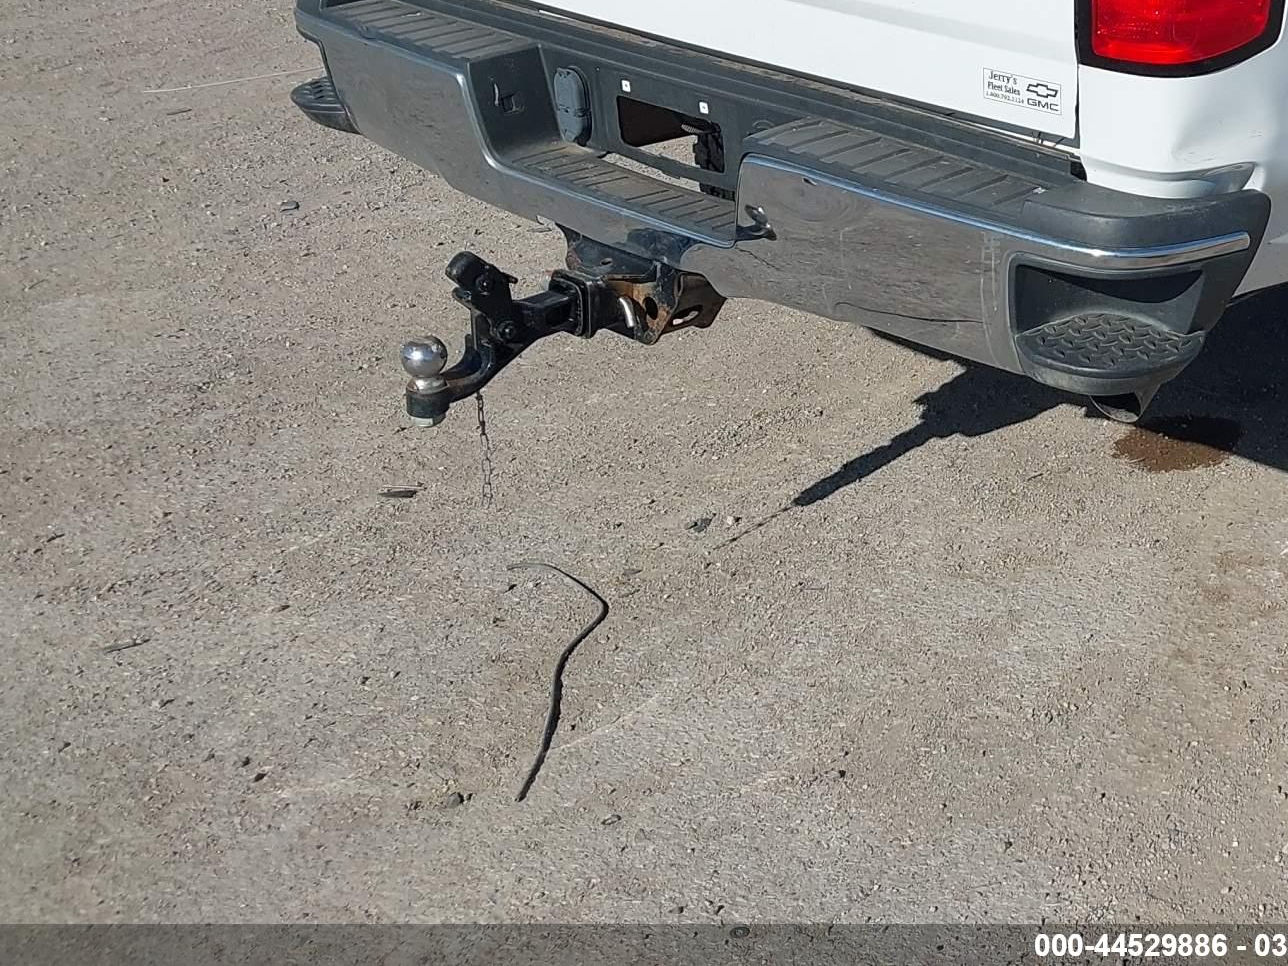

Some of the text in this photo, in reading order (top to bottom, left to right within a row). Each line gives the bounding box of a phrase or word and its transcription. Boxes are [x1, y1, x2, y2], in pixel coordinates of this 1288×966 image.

[988, 70, 1018, 85] Jerry's
[987, 80, 1021, 96] Fleet Sales
[1027, 97, 1060, 112] GMC
